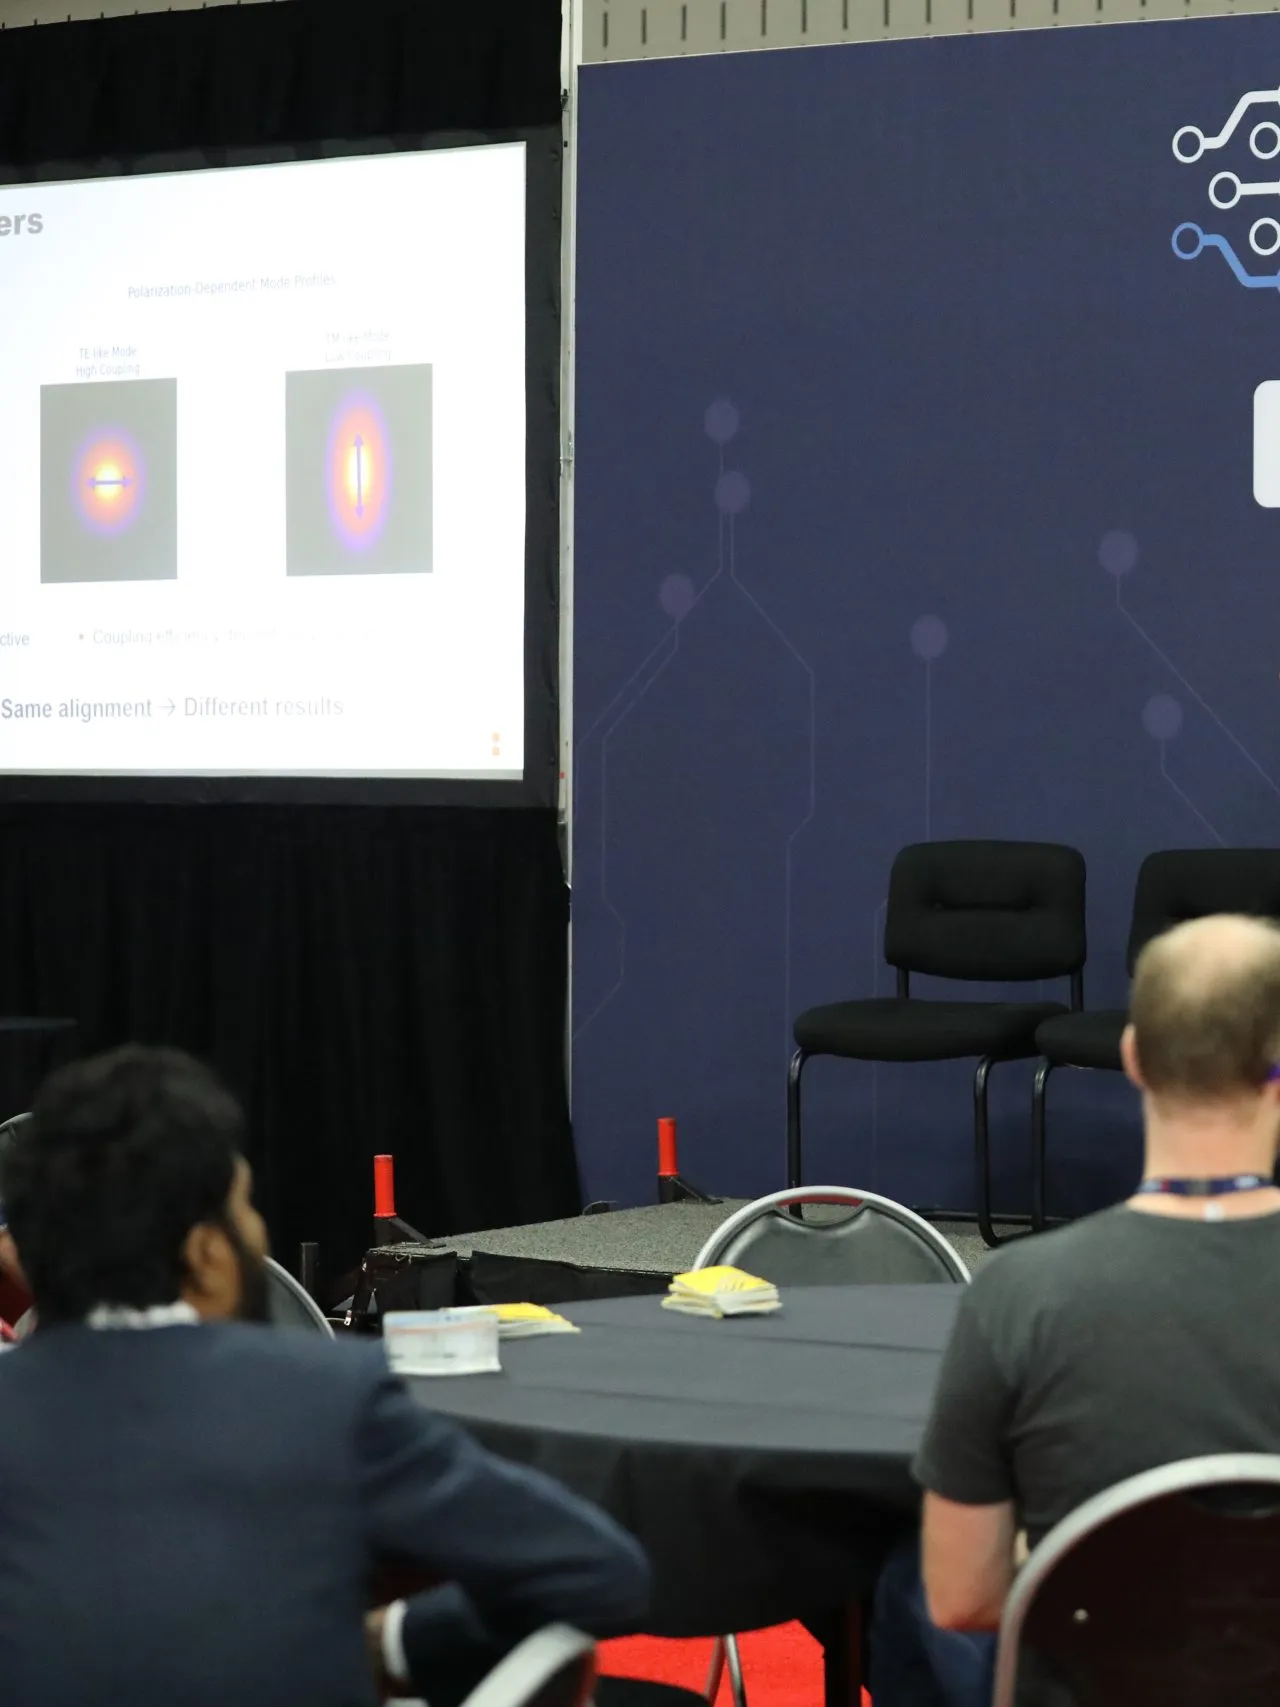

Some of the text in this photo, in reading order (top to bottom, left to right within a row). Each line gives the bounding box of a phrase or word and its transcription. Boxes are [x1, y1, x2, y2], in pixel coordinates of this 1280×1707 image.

[0, 213, 44, 237] ers
[260, 275, 290, 290] Mode
[294, 272, 337, 288] Profiles
[111, 344, 138, 359] Mode
[93, 628, 152, 648] Coupling
[1, 695, 344, 723] Same alignment Different results
